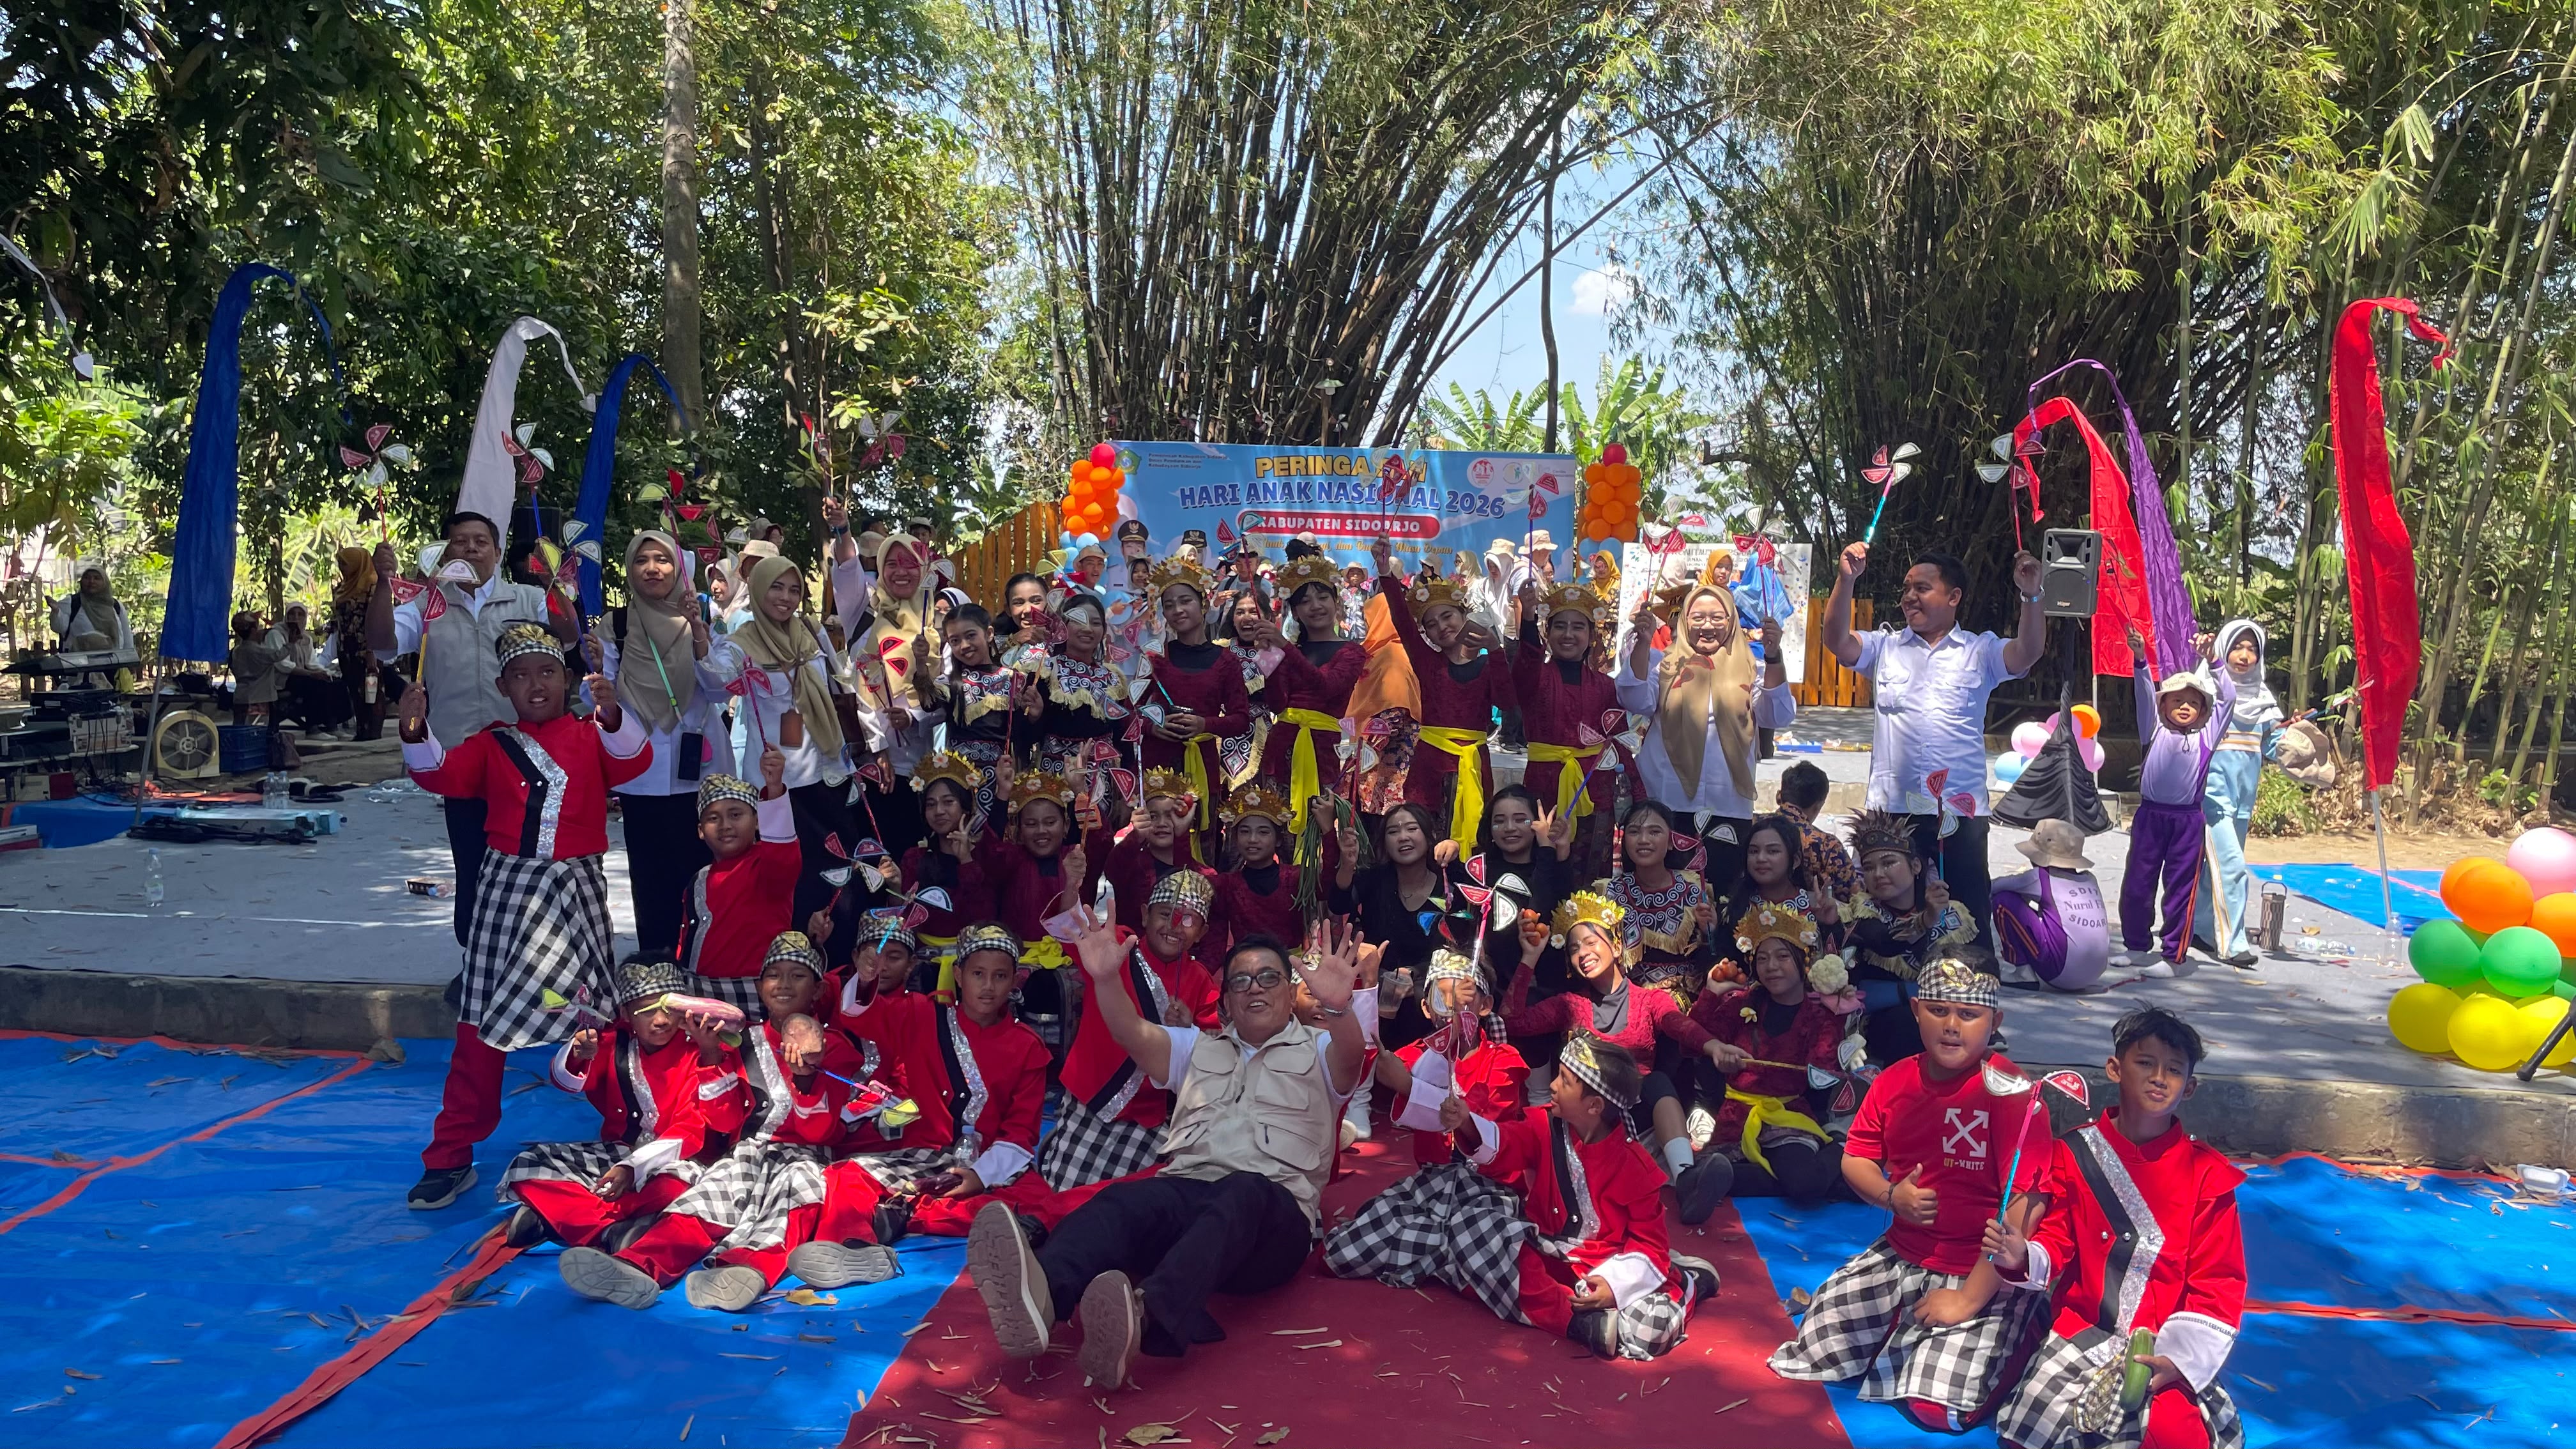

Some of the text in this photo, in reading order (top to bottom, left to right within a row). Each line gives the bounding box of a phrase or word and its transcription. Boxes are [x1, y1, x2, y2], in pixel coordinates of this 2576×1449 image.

[1179, 483, 1241, 509] HARI
[1245, 480, 1313, 504] ANAK
[1445, 490, 1505, 519] 2026
[2064, 899, 2094, 911] Nurul
